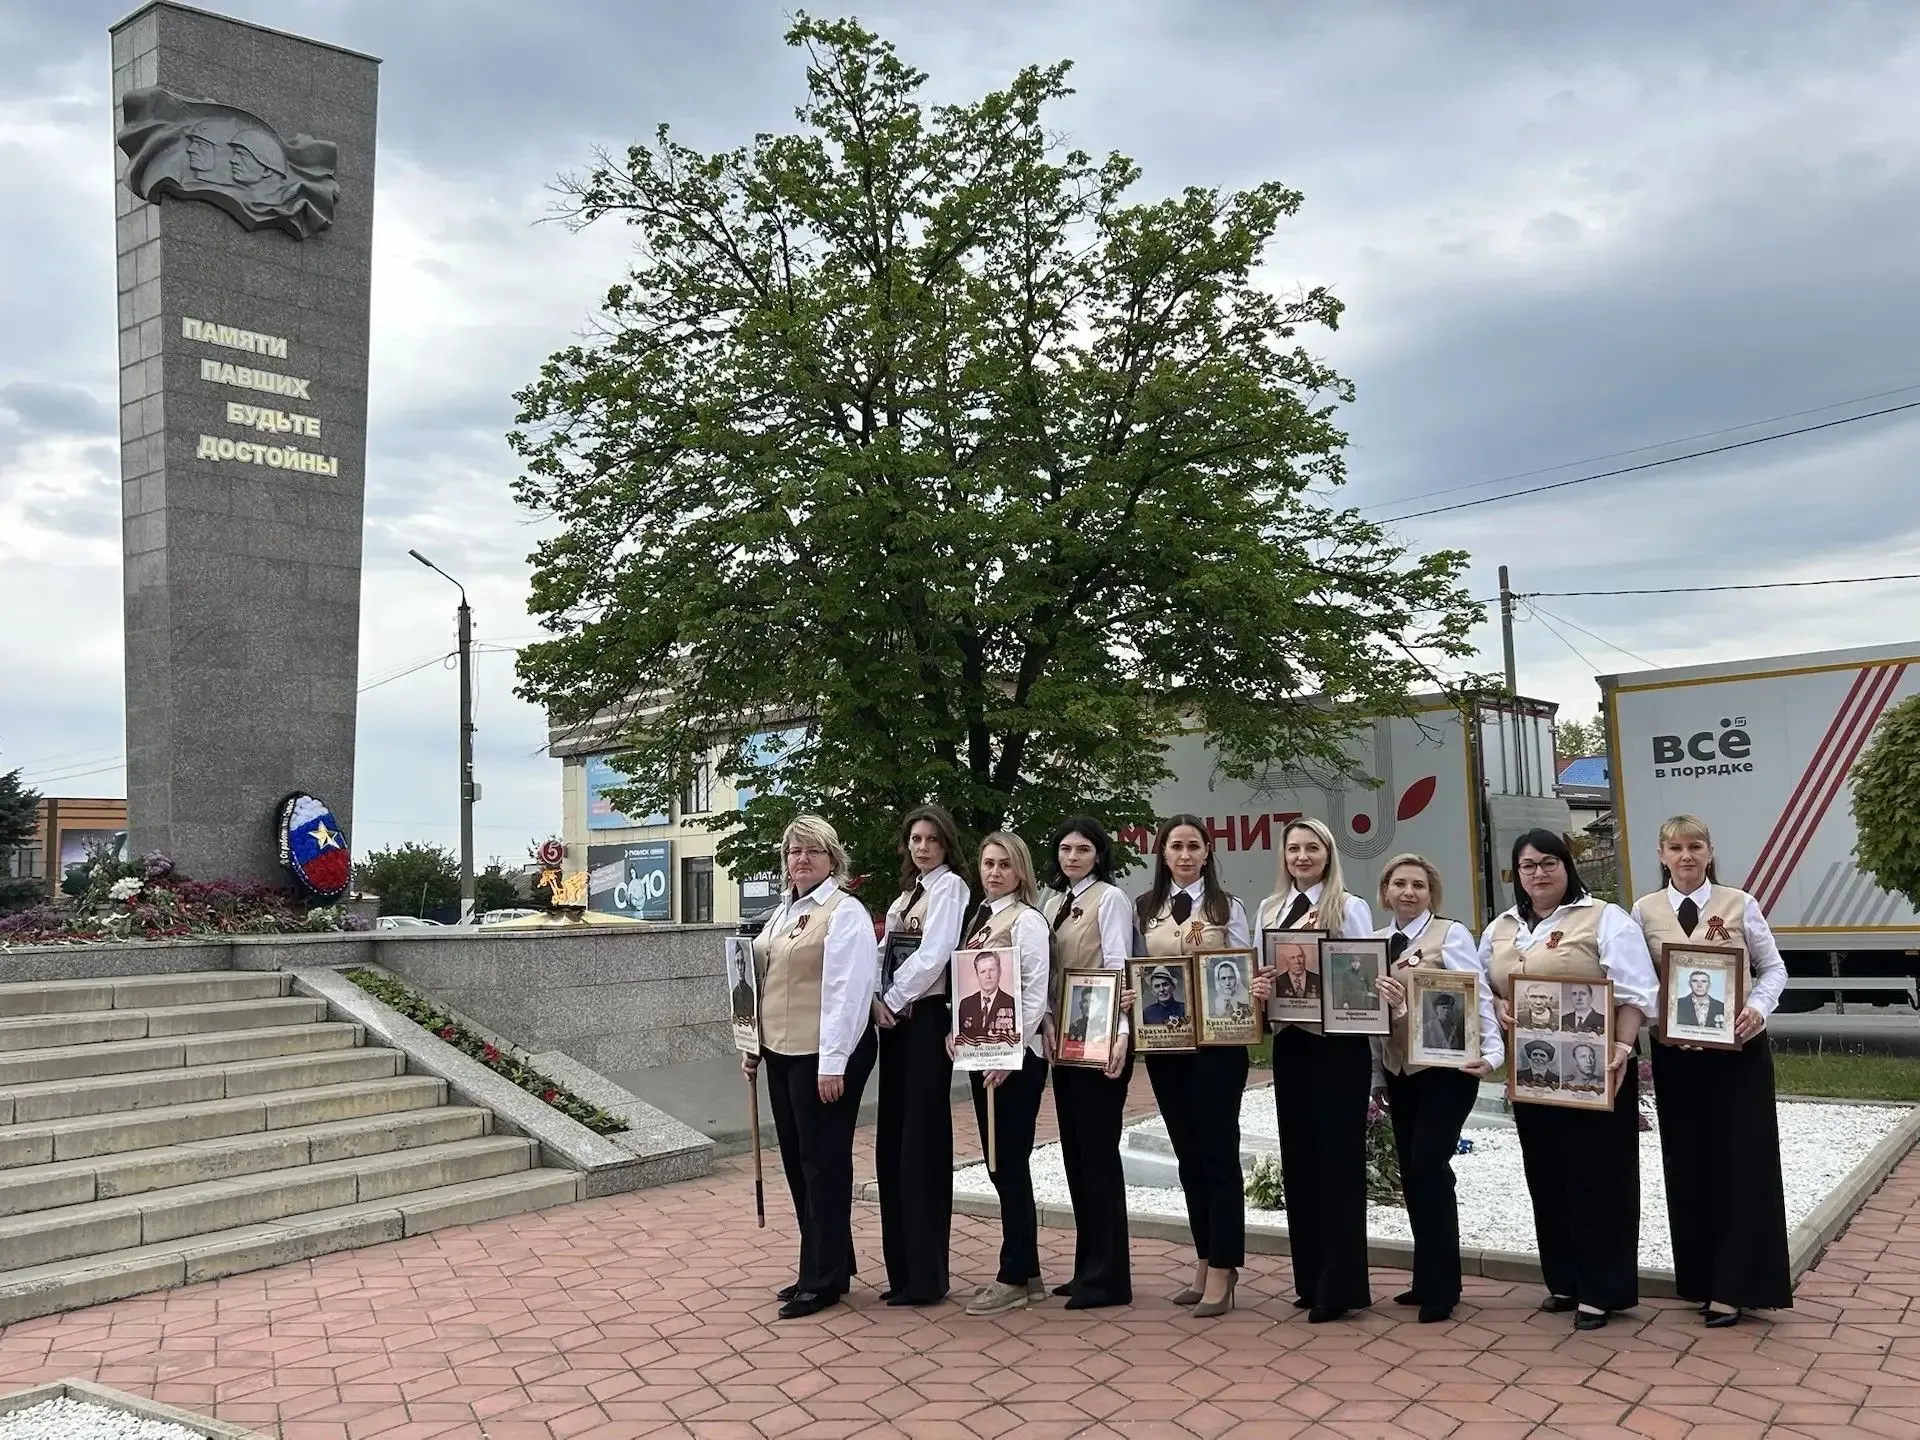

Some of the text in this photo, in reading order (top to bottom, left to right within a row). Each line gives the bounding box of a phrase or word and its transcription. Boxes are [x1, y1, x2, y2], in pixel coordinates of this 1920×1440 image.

[182, 316, 287, 359] ПАМЯТИ
[201, 358, 311, 401] ПАВШИХ
[226, 400, 322, 439] БУДЬТЕ
[196, 433, 339, 478] ДОСТОЙНЫ
[1652, 718, 1751, 764] всё
[1655, 762, 1753, 779] в порядке
